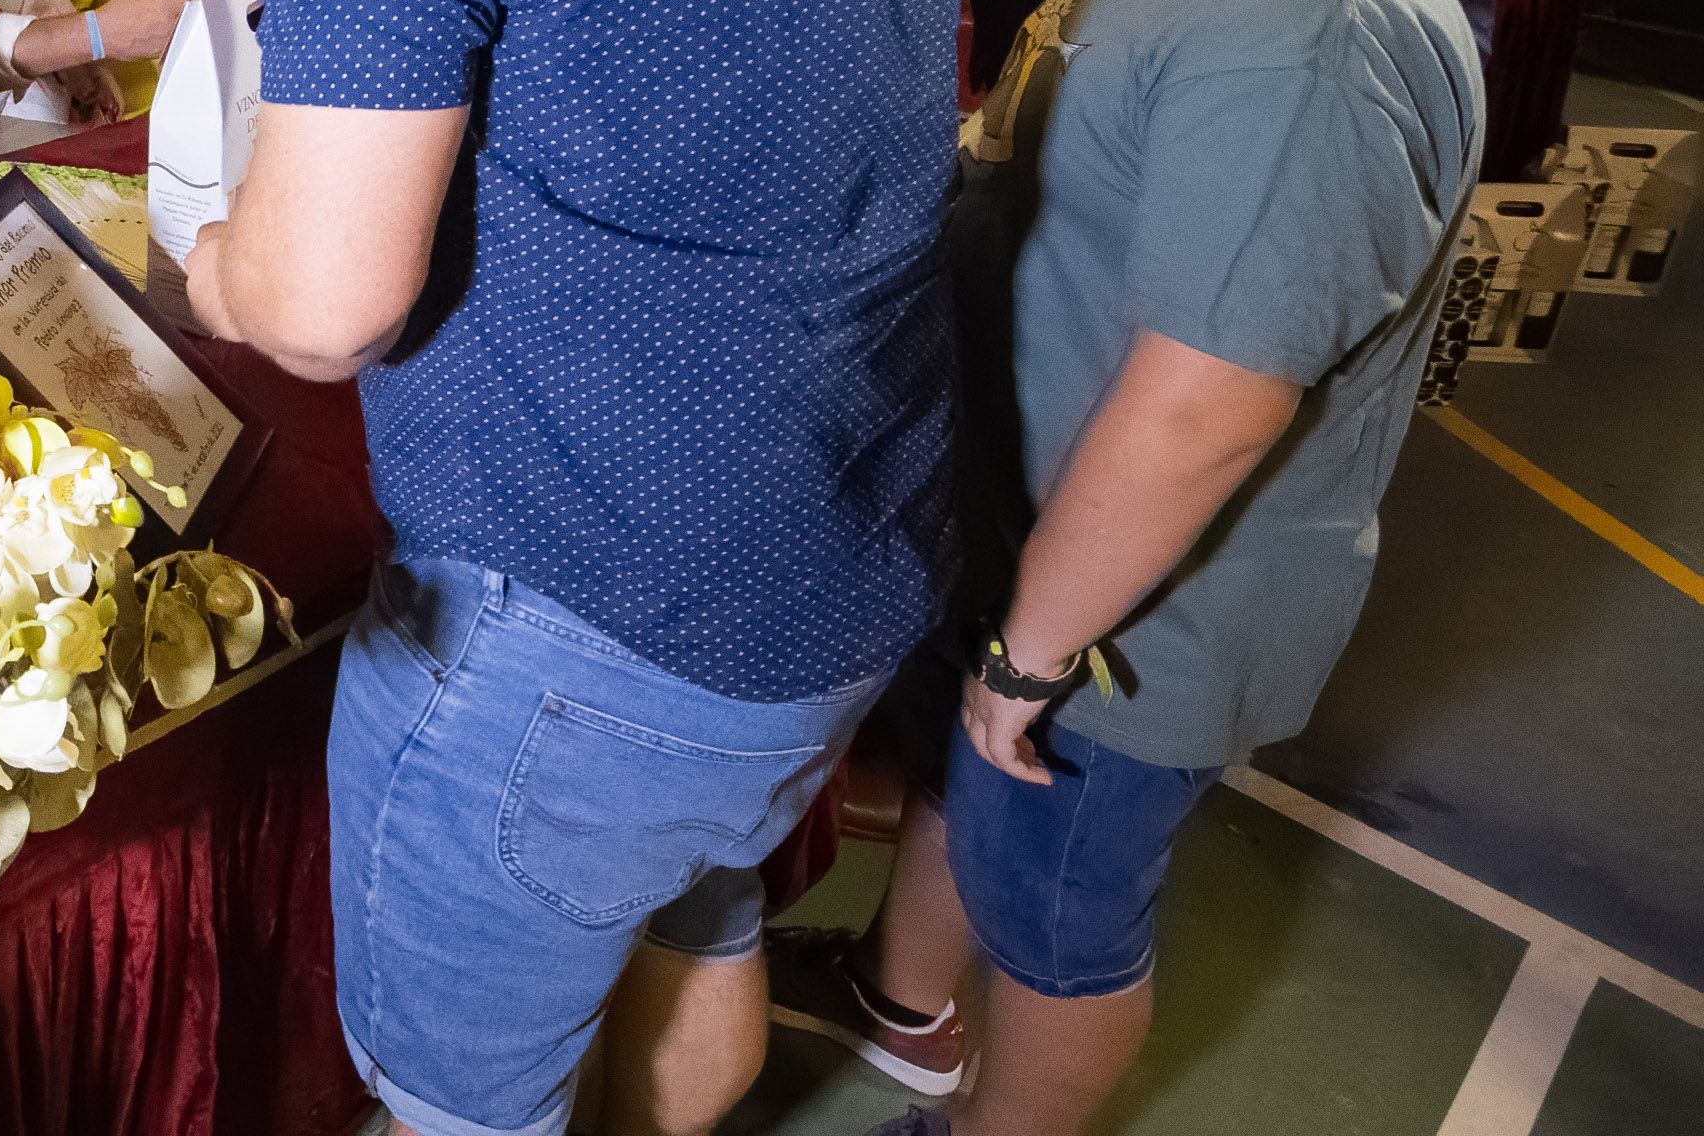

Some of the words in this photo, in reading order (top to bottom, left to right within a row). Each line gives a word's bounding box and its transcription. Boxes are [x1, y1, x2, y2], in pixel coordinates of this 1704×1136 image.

[0, 236, 16, 254] del
[11, 246, 52, 284] Premio
[17, 316, 31, 328] la
[33, 325, 59, 351] Pedro
